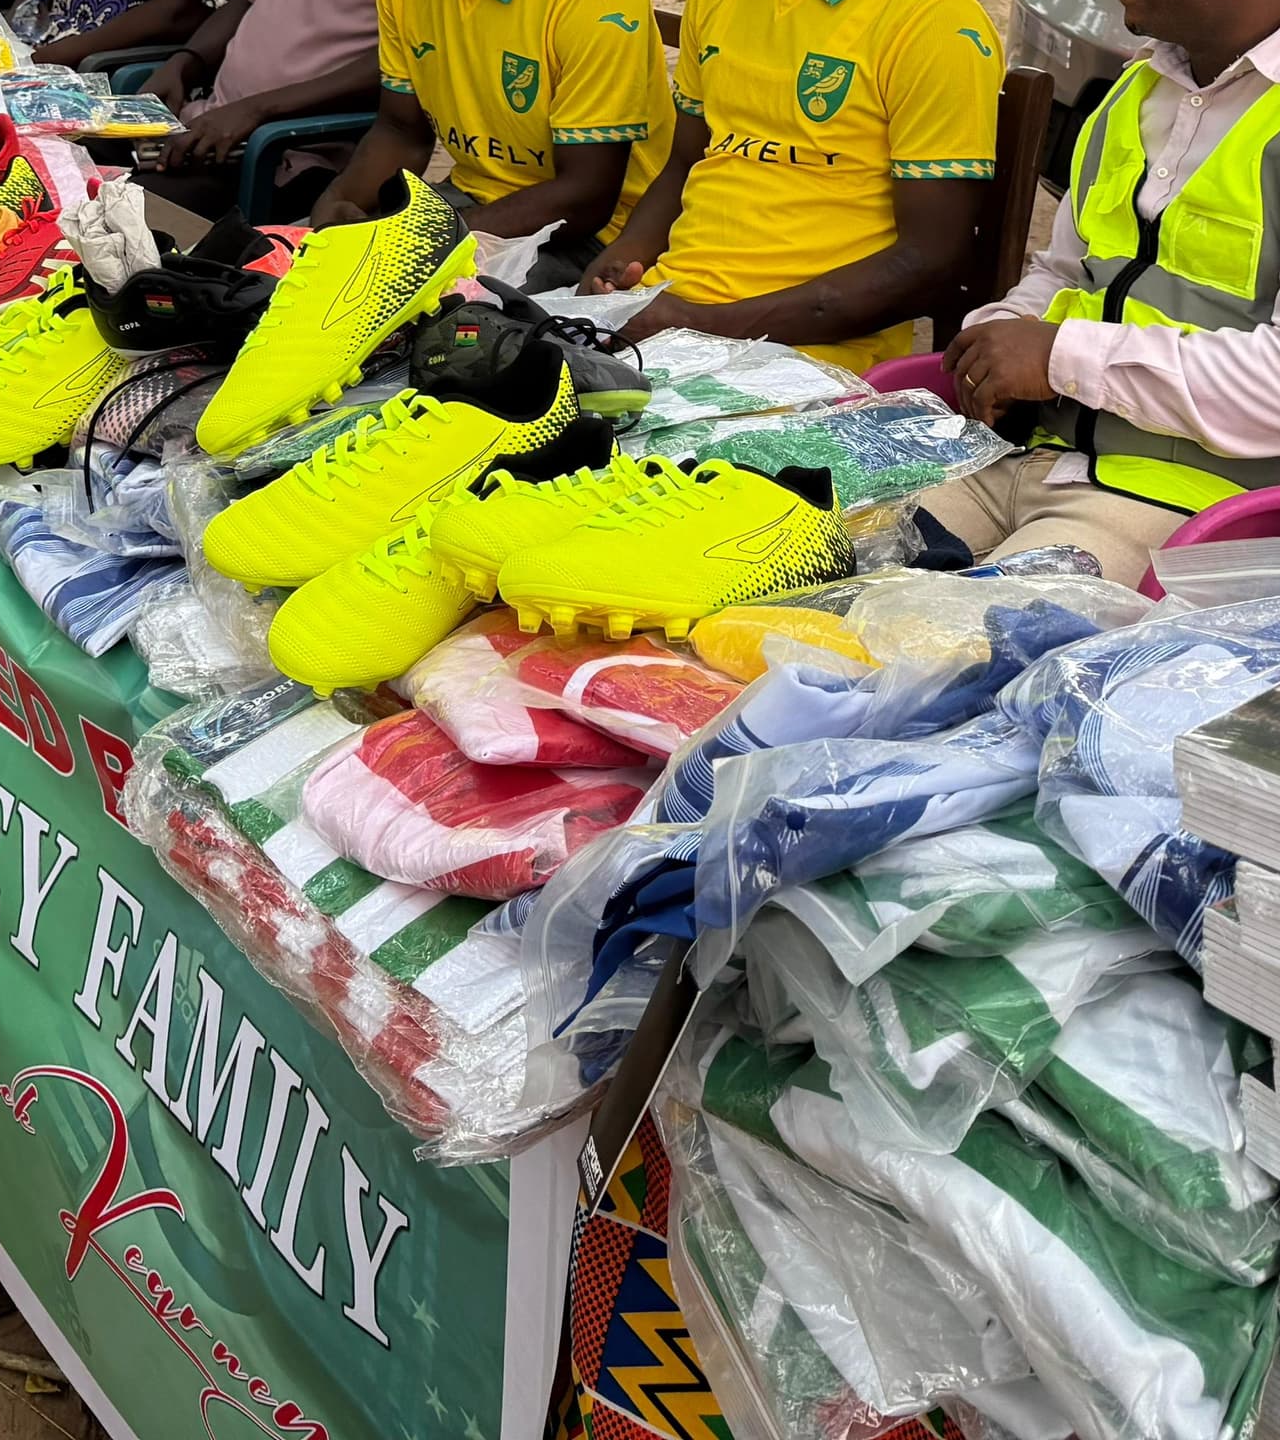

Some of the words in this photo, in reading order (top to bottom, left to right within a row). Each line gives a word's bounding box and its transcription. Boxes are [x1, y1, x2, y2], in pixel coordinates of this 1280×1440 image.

[713, 133, 841, 166] AKELY
[239, 679, 295, 711] SPORT
[73, 866, 410, 1350] FAMILY
